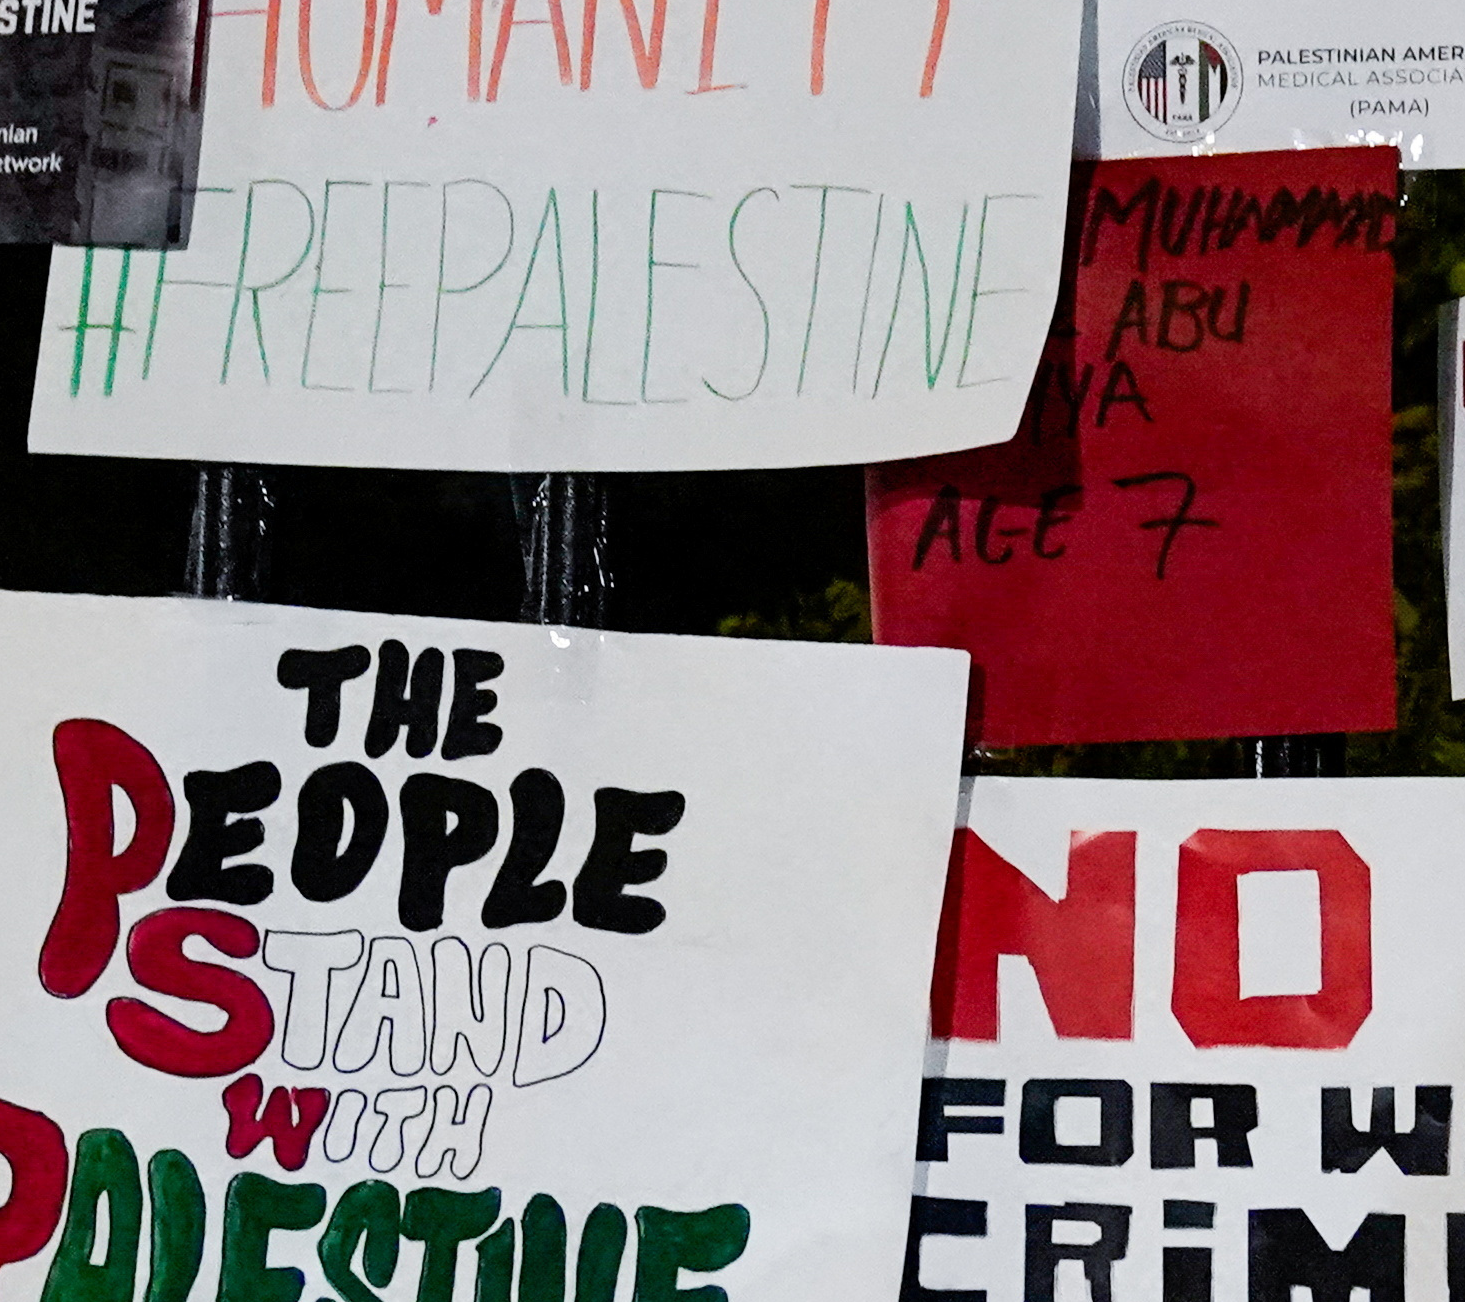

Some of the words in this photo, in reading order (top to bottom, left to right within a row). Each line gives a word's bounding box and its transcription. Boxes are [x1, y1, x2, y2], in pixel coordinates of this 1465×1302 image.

[1256, 46, 1395, 67] PALESTINIAN
[1256, 68, 1360, 89] MEDICAL
[1348, 97, 1431, 119] (PAMA)
[1105, 279, 1252, 362] ABU
[911, 483, 1084, 573] AGE
[1112, 471, 1223, 581] 7
[275, 638, 505, 763] THE
[37, 716, 685, 999] PEOPLE
[930, 825, 1373, 1050] NO
[105, 905, 607, 1088] STAND
[223, 1072, 493, 1181] WITH
[914, 1076, 1259, 1170] FOR
